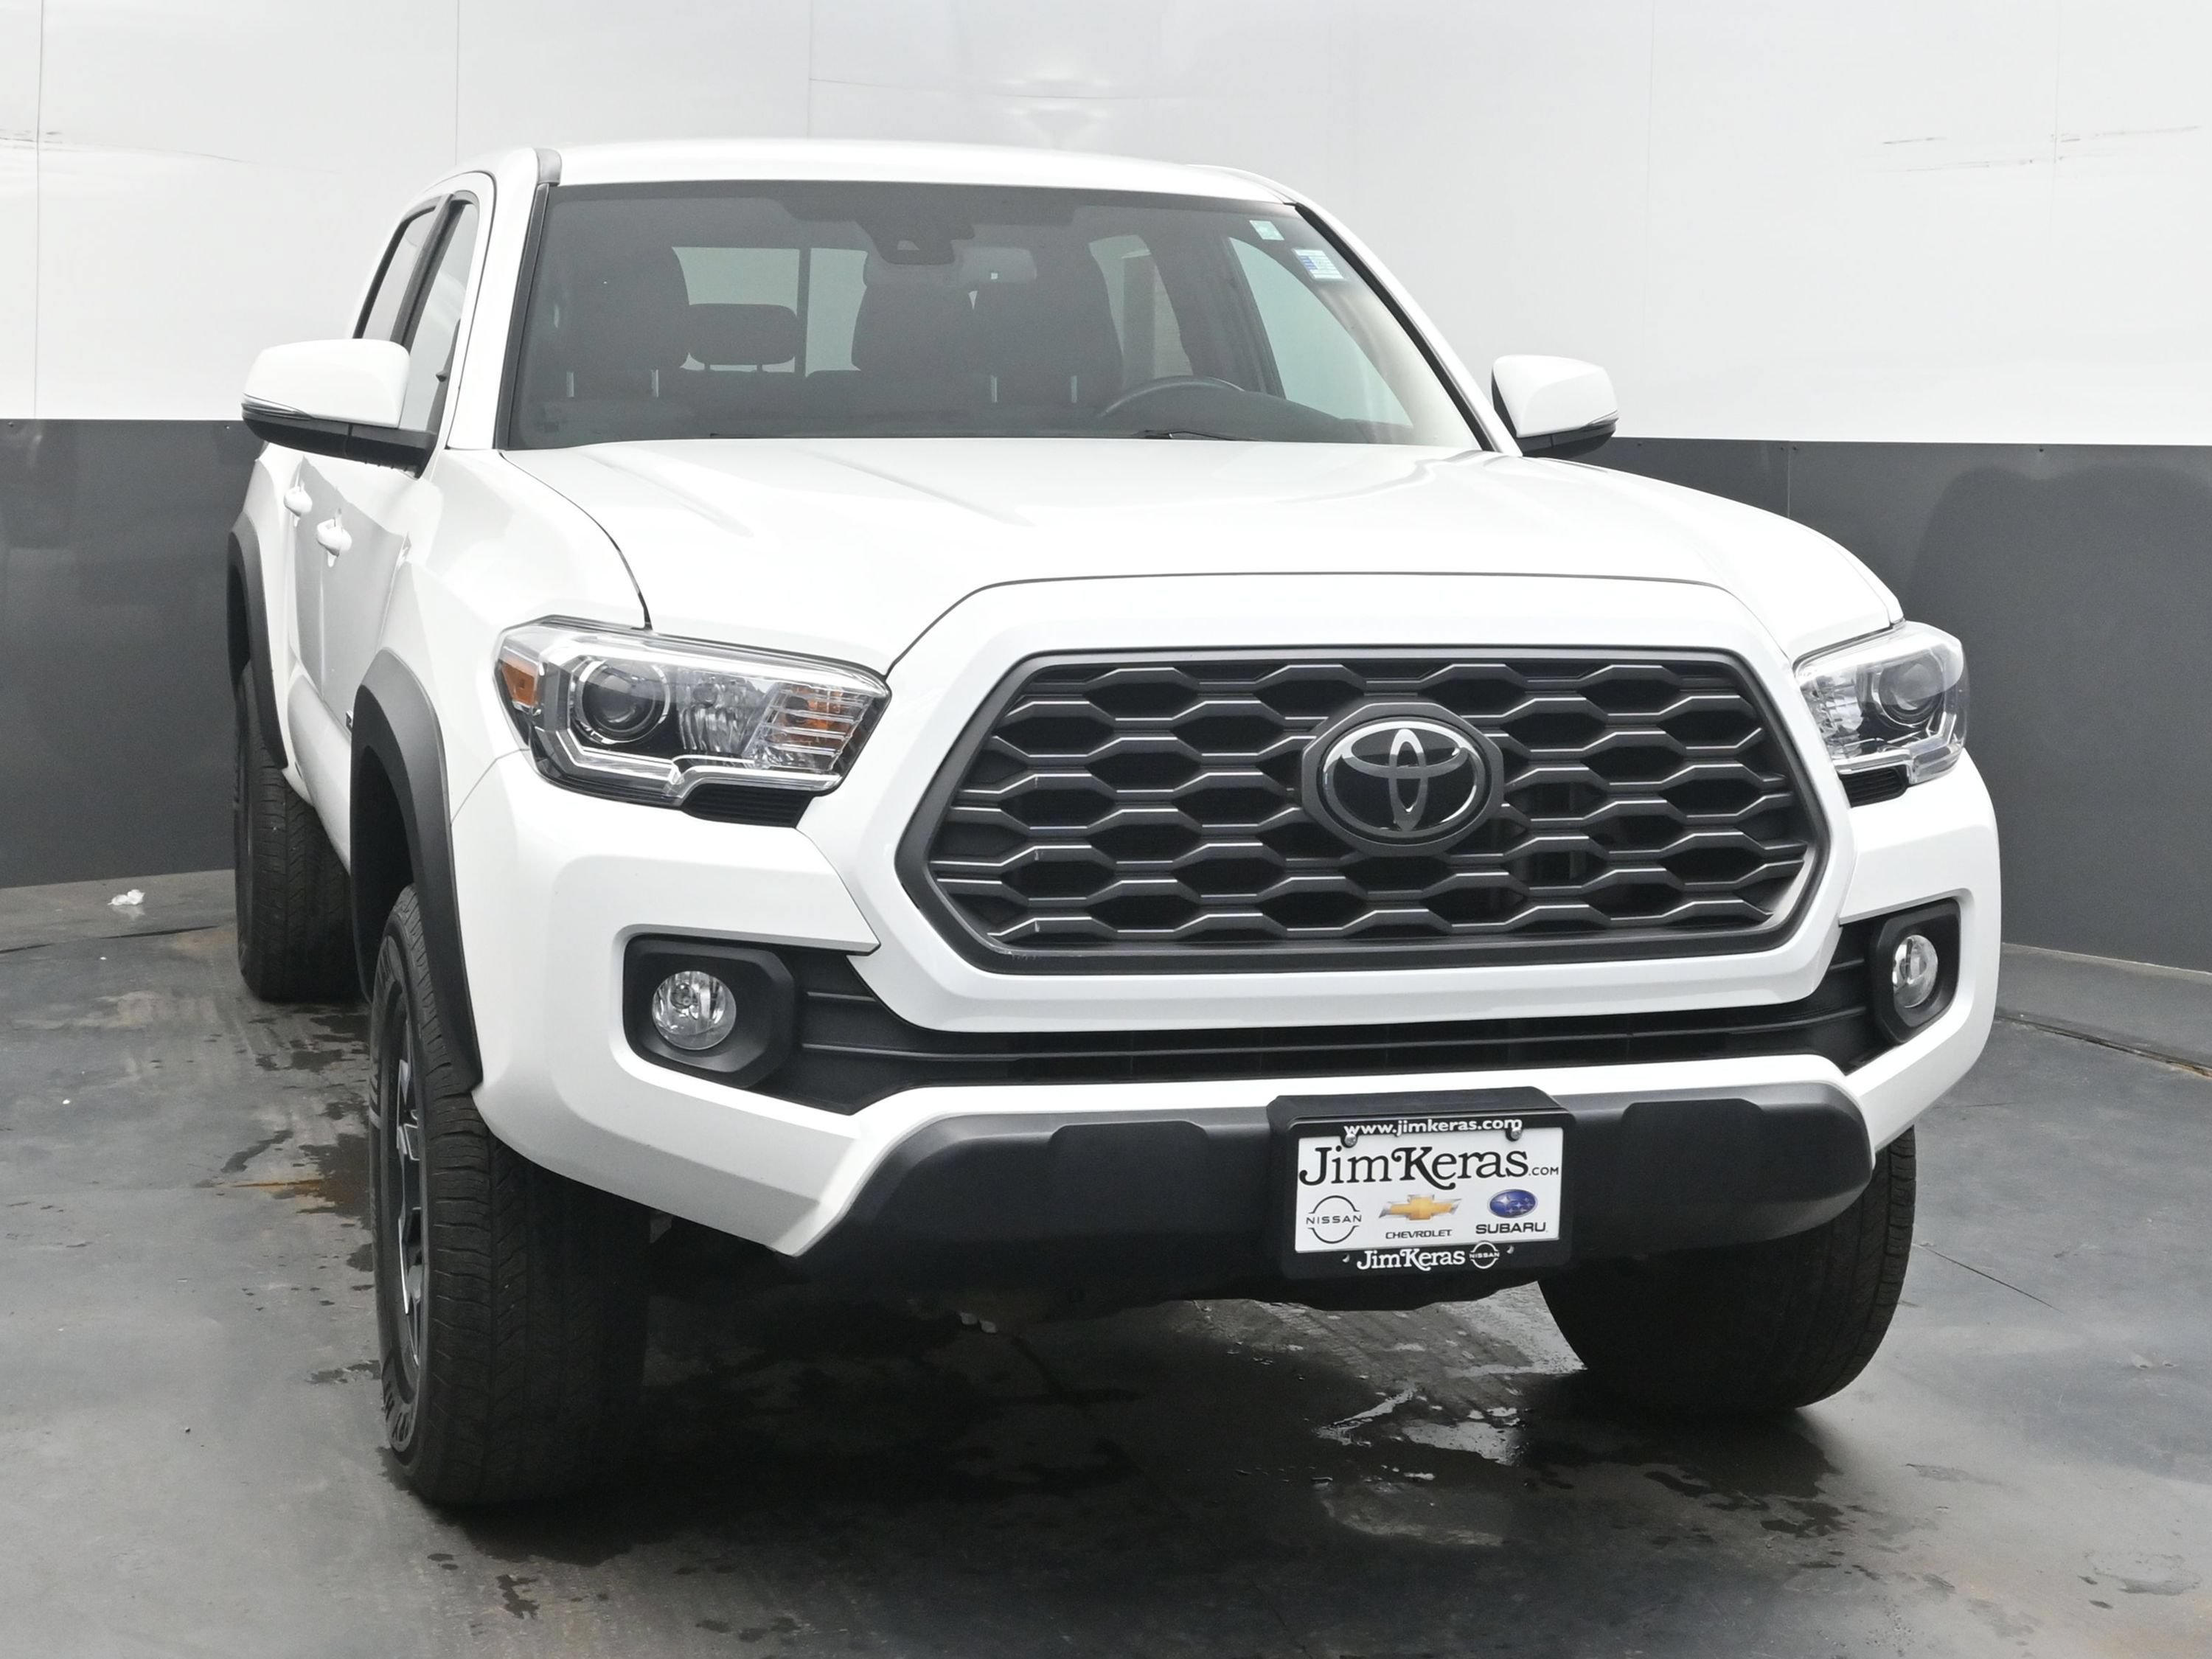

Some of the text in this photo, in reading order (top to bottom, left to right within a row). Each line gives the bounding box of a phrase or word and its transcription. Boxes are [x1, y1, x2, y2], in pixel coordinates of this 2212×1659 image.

[1344, 1119, 1523, 1136] www.jimkeras.com
[1306, 1214, 1363, 1225] NISSAN
[1385, 1229, 1453, 1239] CHEVROLET
[1475, 1222, 1546, 1235] SUBARU
